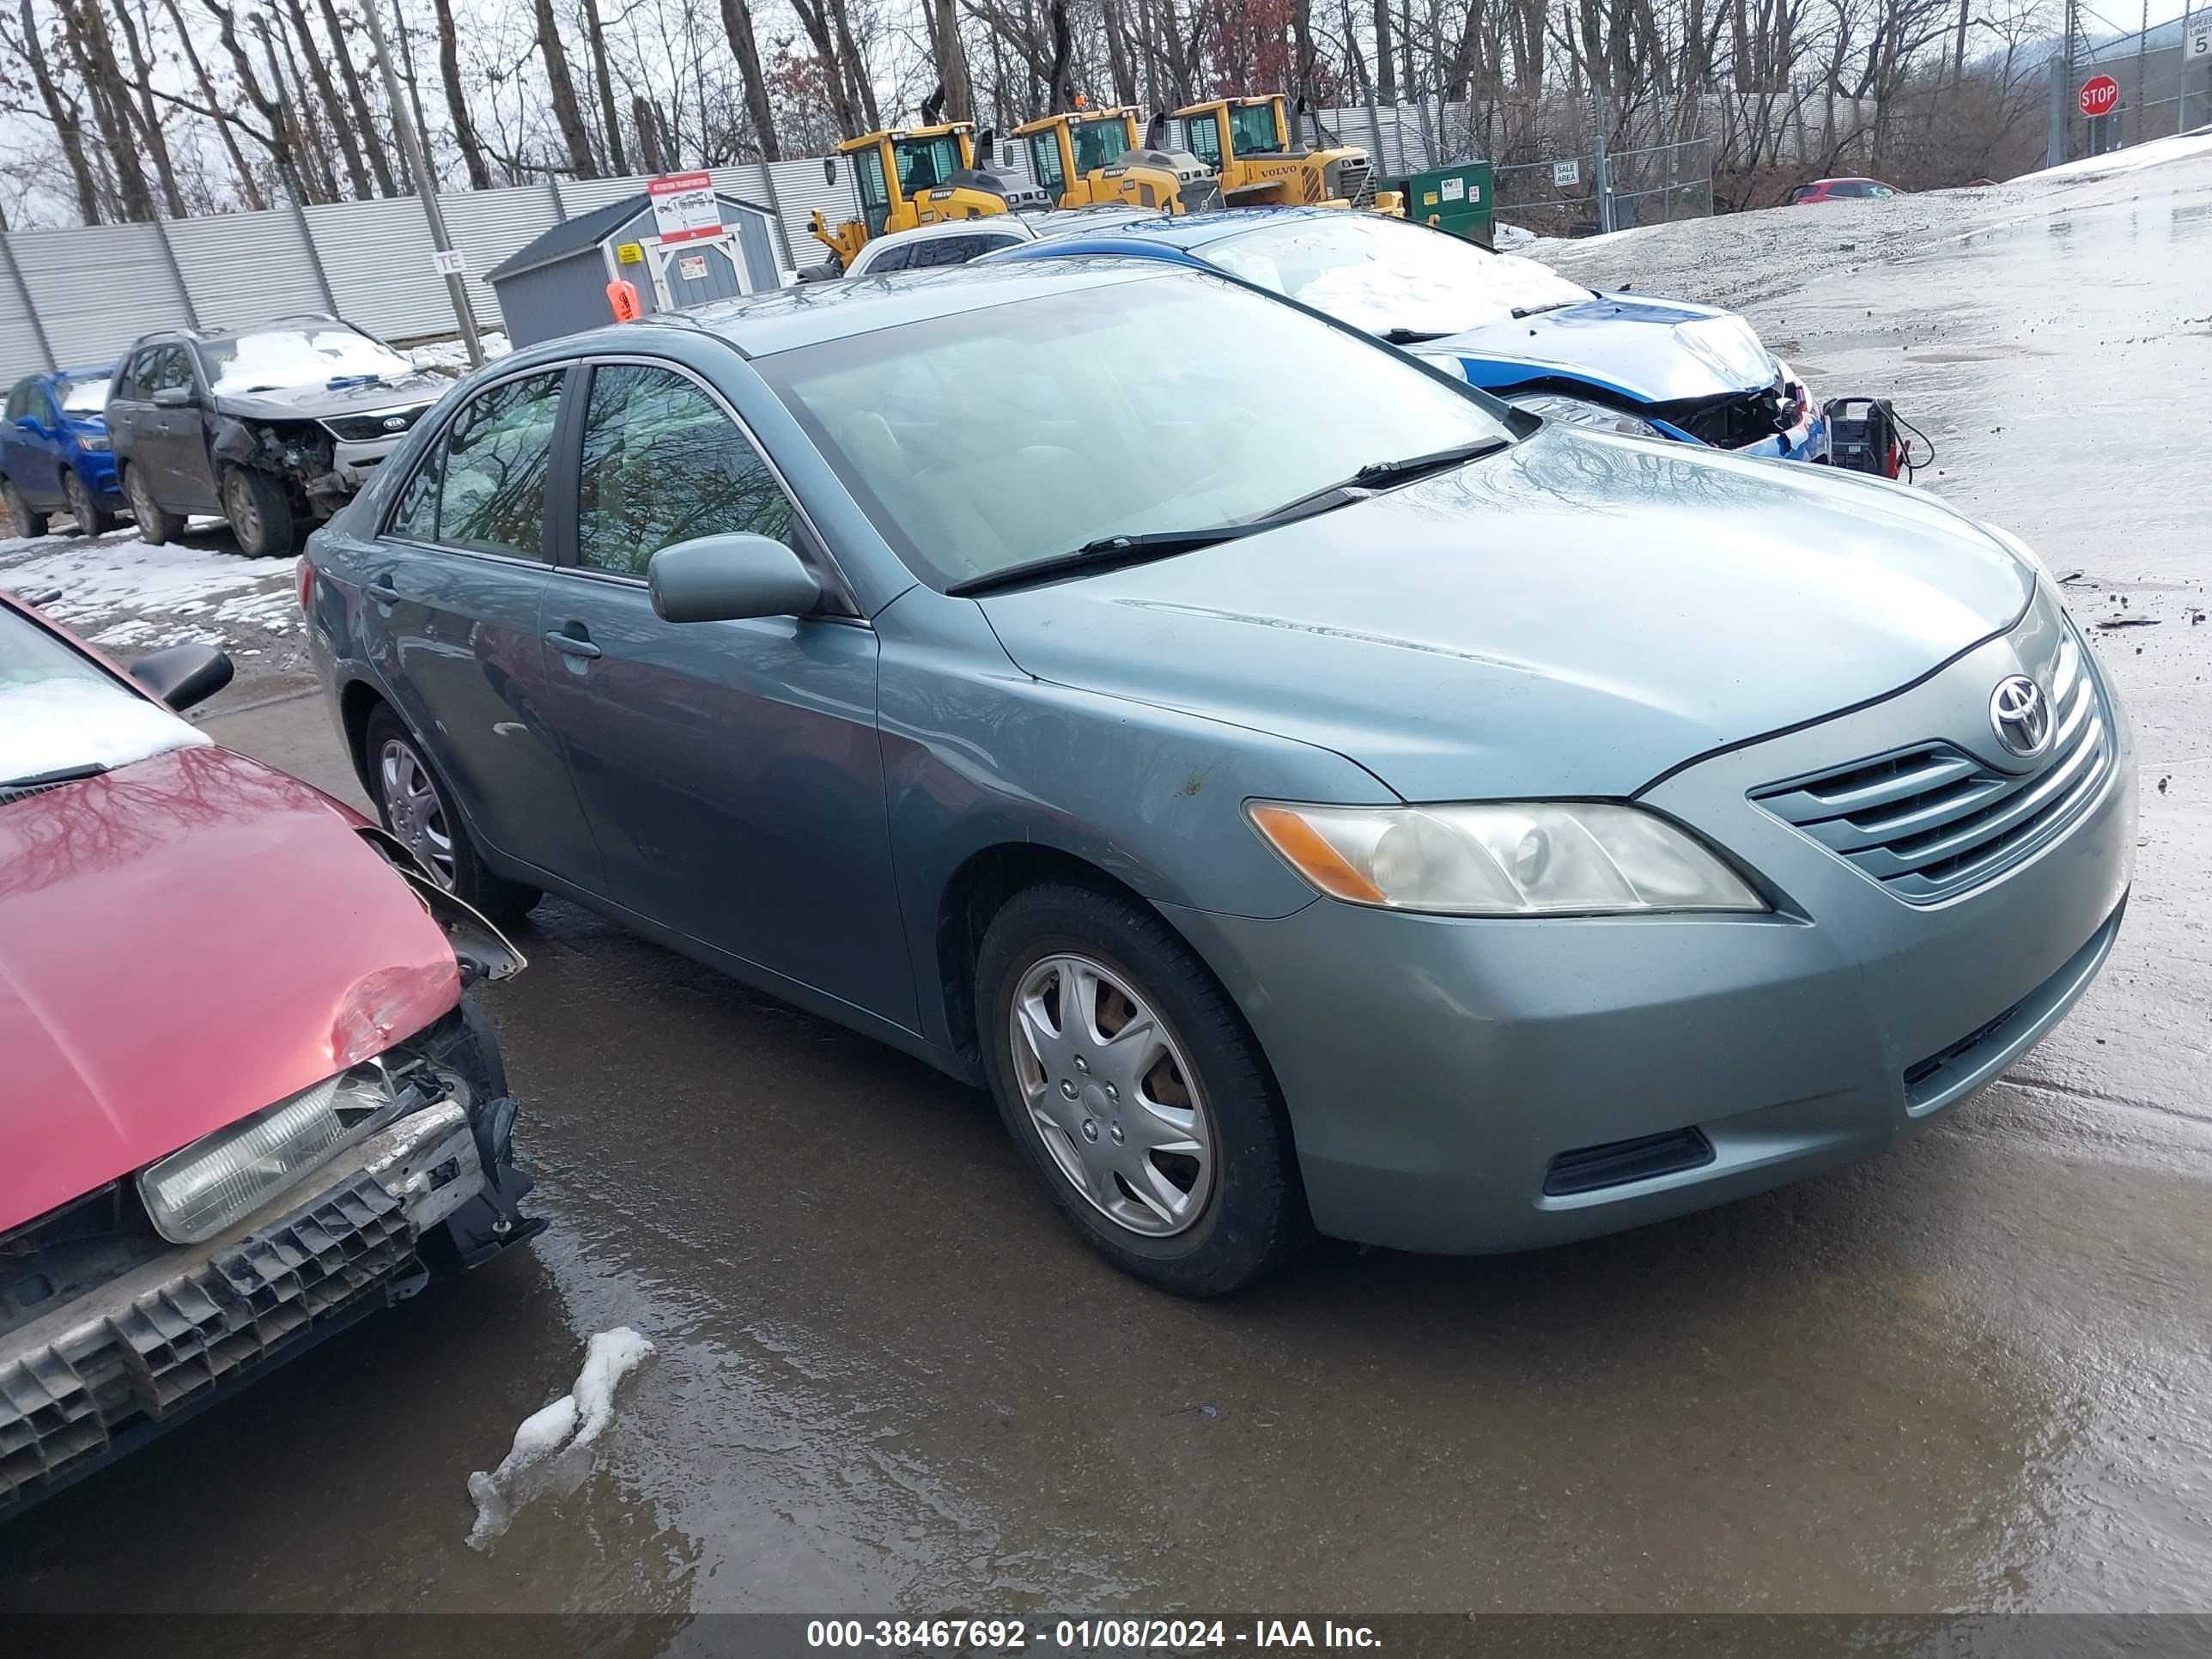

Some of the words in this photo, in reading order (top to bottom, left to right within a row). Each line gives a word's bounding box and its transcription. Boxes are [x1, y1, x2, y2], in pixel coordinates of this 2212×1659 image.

[2190, 27, 2212, 37] LIMIT
[2195, 36, 2208, 53] 5
[2081, 86, 2116, 106] STOP
[1104, 168, 1127, 177] VOLVO
[1261, 164, 1297, 178] VOLVO
[1557, 164, 1575, 173] SALE
[1558, 173, 1576, 182] AREA
[931, 189, 953, 199] VOLVO
[436, 254, 461, 270] TE
